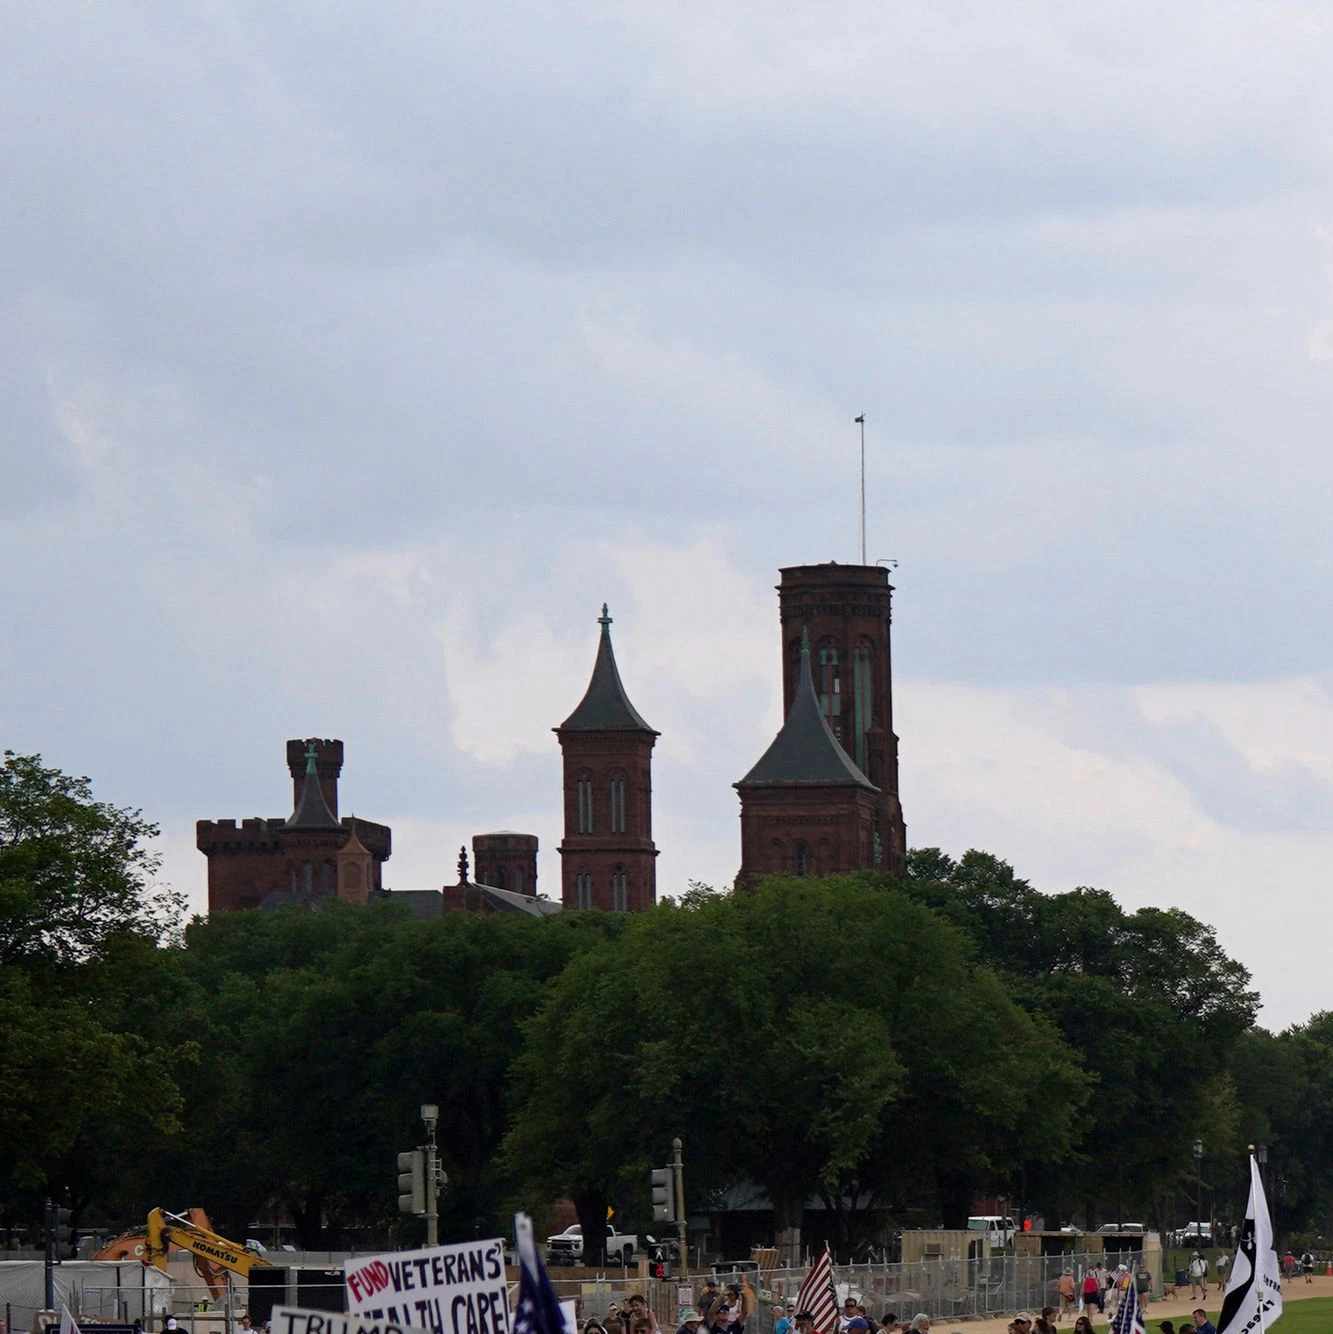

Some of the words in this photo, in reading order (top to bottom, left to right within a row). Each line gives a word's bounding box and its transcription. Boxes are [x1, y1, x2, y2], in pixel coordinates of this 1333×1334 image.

[192, 1240, 239, 1264] KOMATSU
[346, 1259, 389, 1303] FUND
[388, 1243, 502, 1293] VETERANS'
